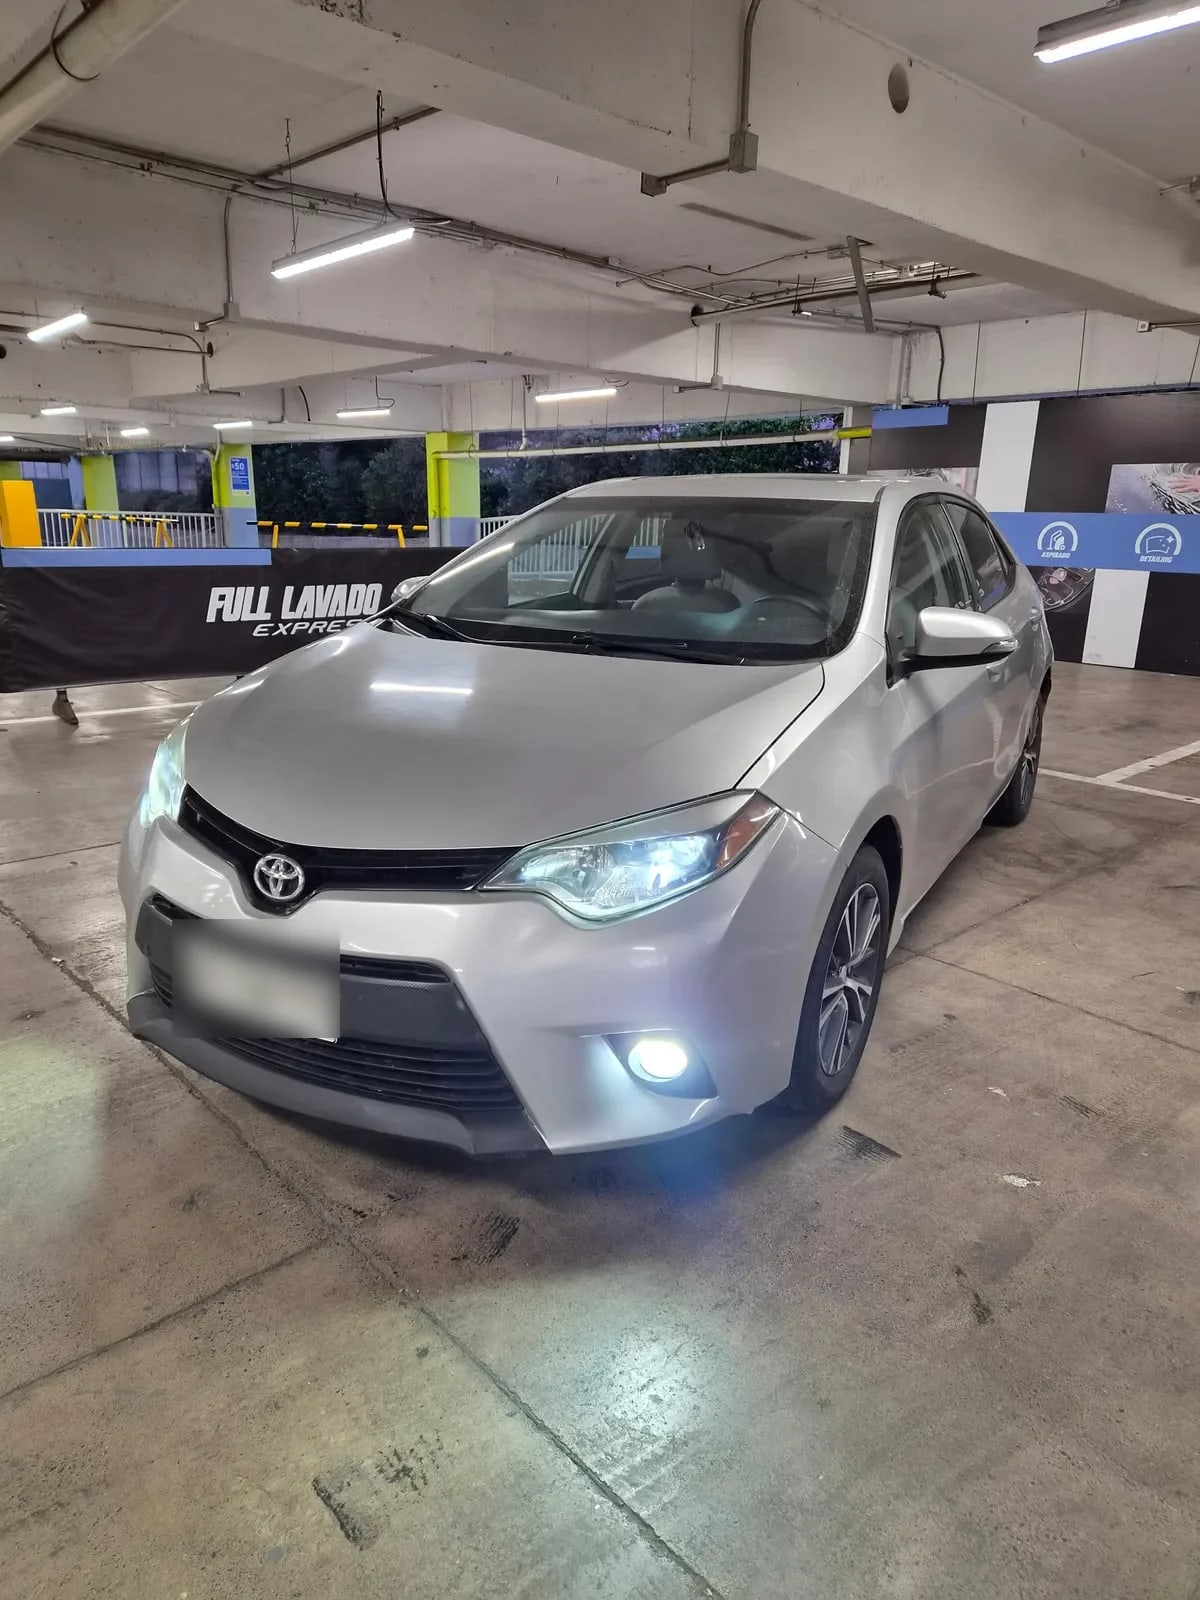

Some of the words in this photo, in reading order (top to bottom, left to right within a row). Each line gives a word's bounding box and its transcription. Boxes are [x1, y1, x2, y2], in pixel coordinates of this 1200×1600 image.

[1041, 551, 1071, 559] ASPIRADO
[1139, 555, 1173, 564] DETAILING
[206, 586, 272, 623] FULL
[281, 583, 383, 620] LAVADO
